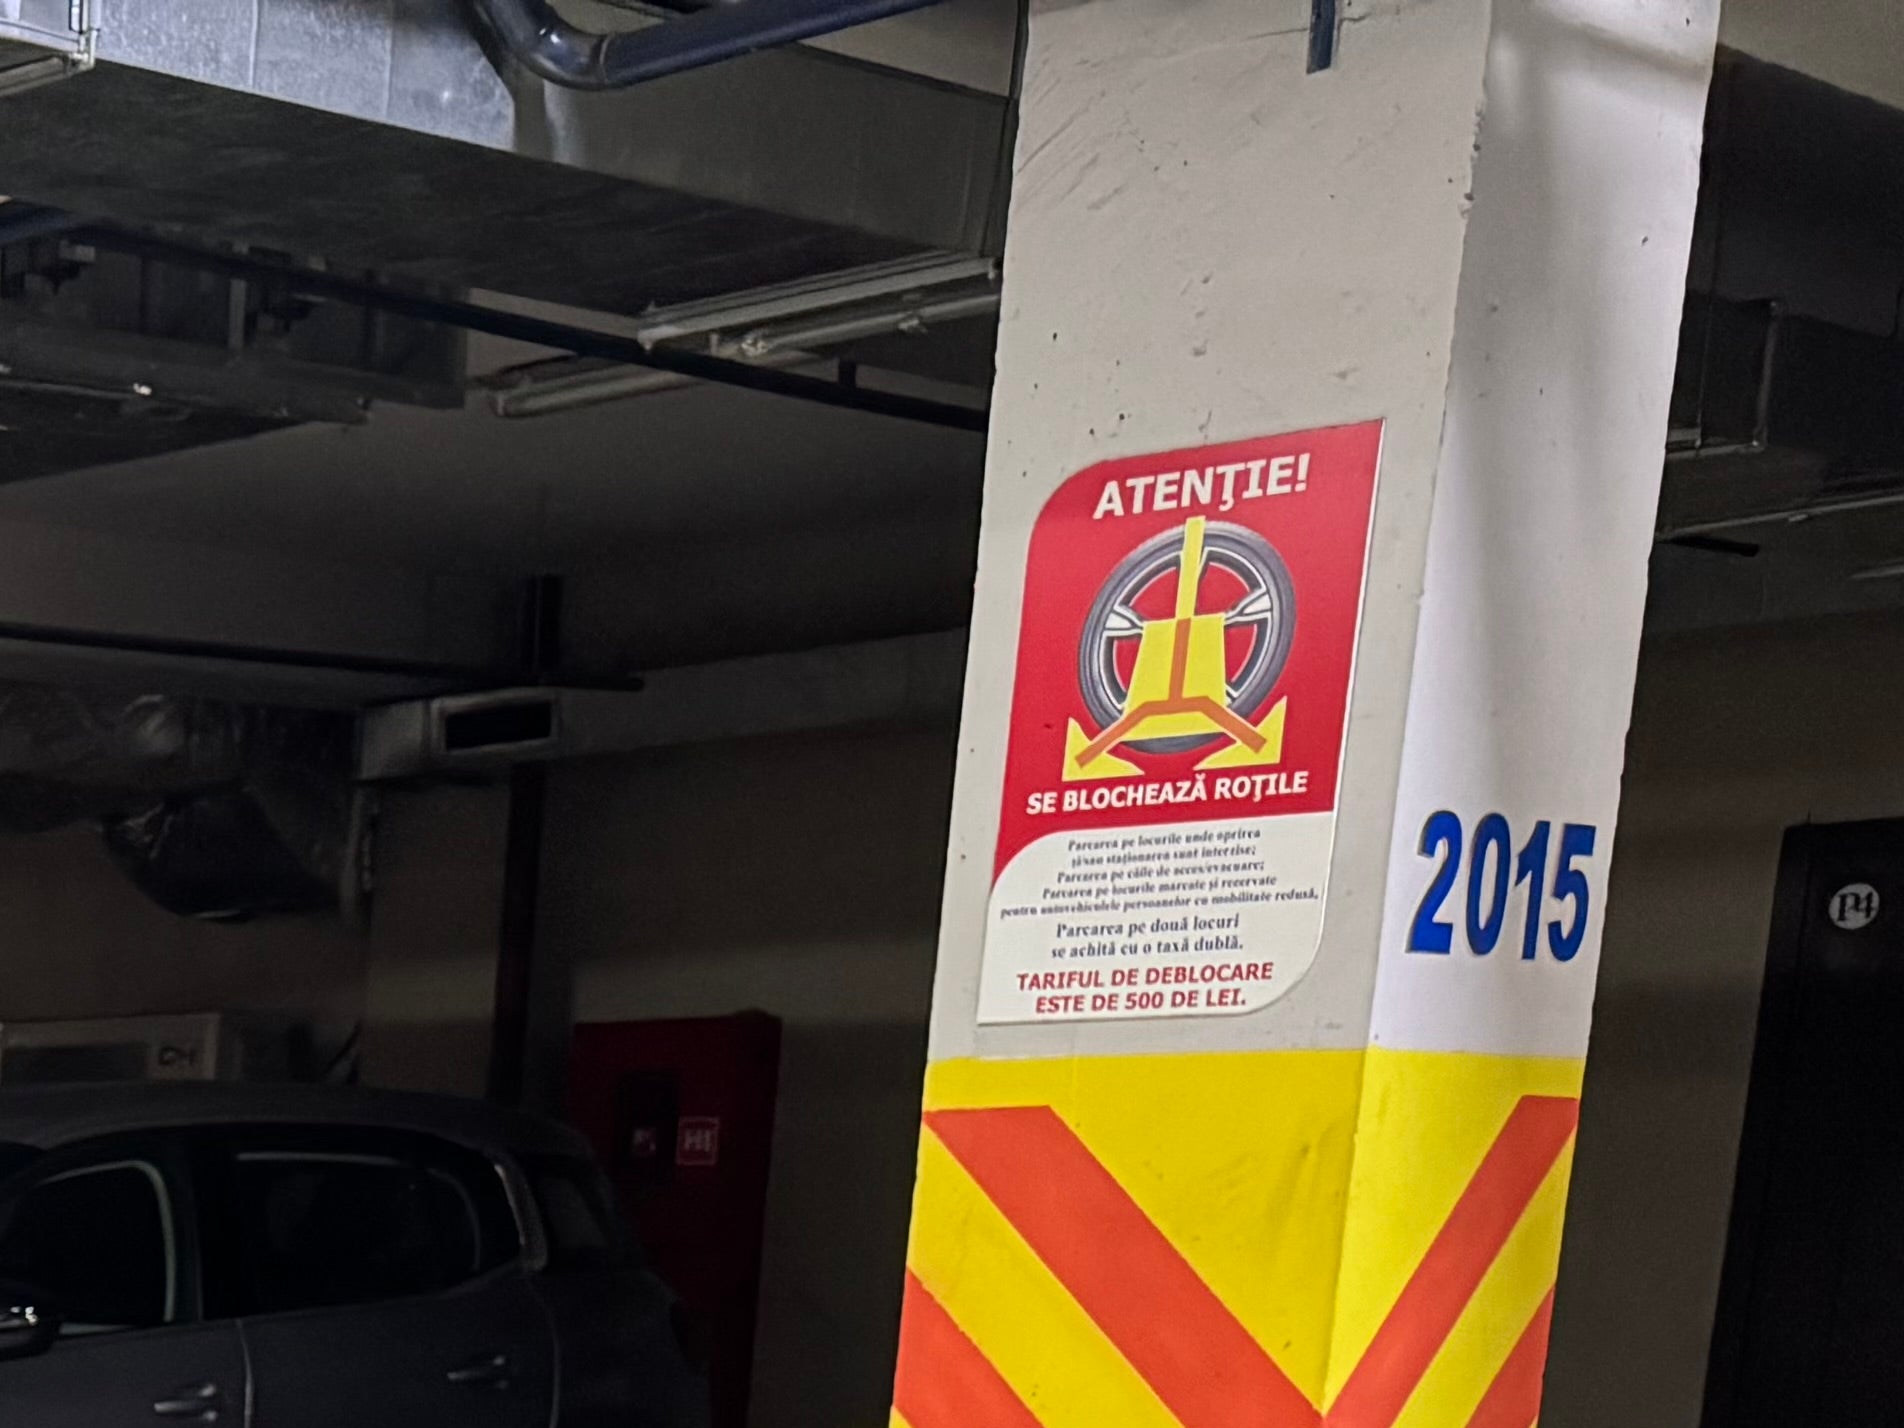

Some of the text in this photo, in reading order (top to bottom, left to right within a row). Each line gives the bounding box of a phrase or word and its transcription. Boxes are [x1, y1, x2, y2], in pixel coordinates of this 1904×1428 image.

[1026, 791, 1058, 815] SE
[1062, 773, 1208, 812] BLOCHEAZĂ
[1405, 810, 1597, 962] 2015
[1056, 911, 1240, 938] Parcarea pe două locuri
[1051, 947, 1066, 959] se
[1120, 942, 1138, 954] cu
[1142, 941, 1152, 953] o
[1155, 937, 1190, 953] taxă
[1194, 934, 1244, 952] dublă.
[1016, 961, 1274, 991] TARIFUL DE DEBLOCARE
[1035, 986, 1246, 1014] ESTE DE 500 DE LEI.
